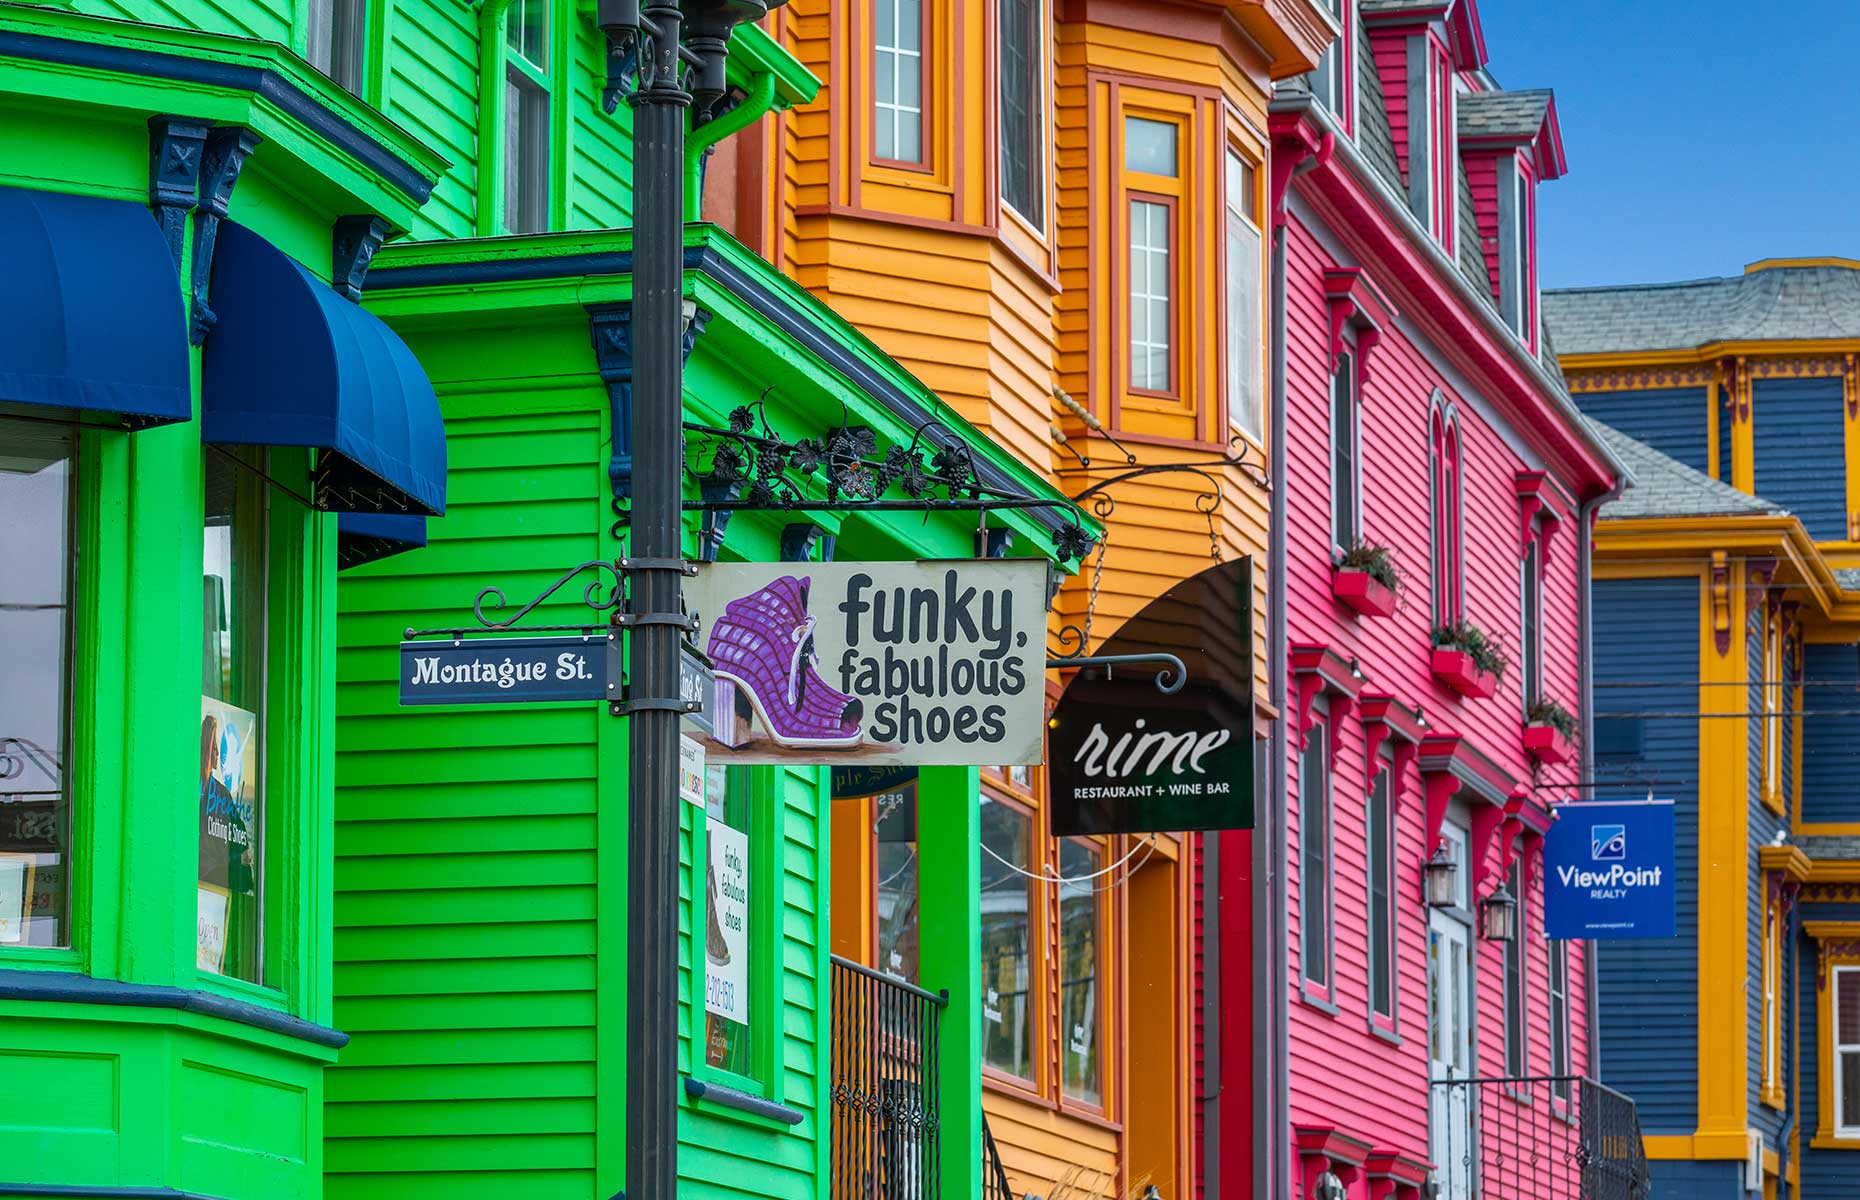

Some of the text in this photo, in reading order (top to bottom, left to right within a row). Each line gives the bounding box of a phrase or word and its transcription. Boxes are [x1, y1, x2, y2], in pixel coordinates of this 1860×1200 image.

[838, 569, 1028, 660] funky,
[411, 653, 593, 689] Montague St.
[838, 643, 1026, 699] fabulous
[869, 694, 1007, 744] shoes
[1073, 718, 1231, 777] rime
[206, 771, 253, 821] Breathe
[1074, 785, 1153, 799] RESTAURANT
[1169, 783, 1202, 796] WINE
[1207, 783, 1230, 795] BAR
[208, 815, 228, 845] Clothing
[232, 823, 247, 847] Shoes
[721, 873, 745, 905] fabulous
[1557, 864, 1662, 888] ViewPoint
[1590, 889, 1627, 899] REALTY
[725, 904, 742, 933] shoes
